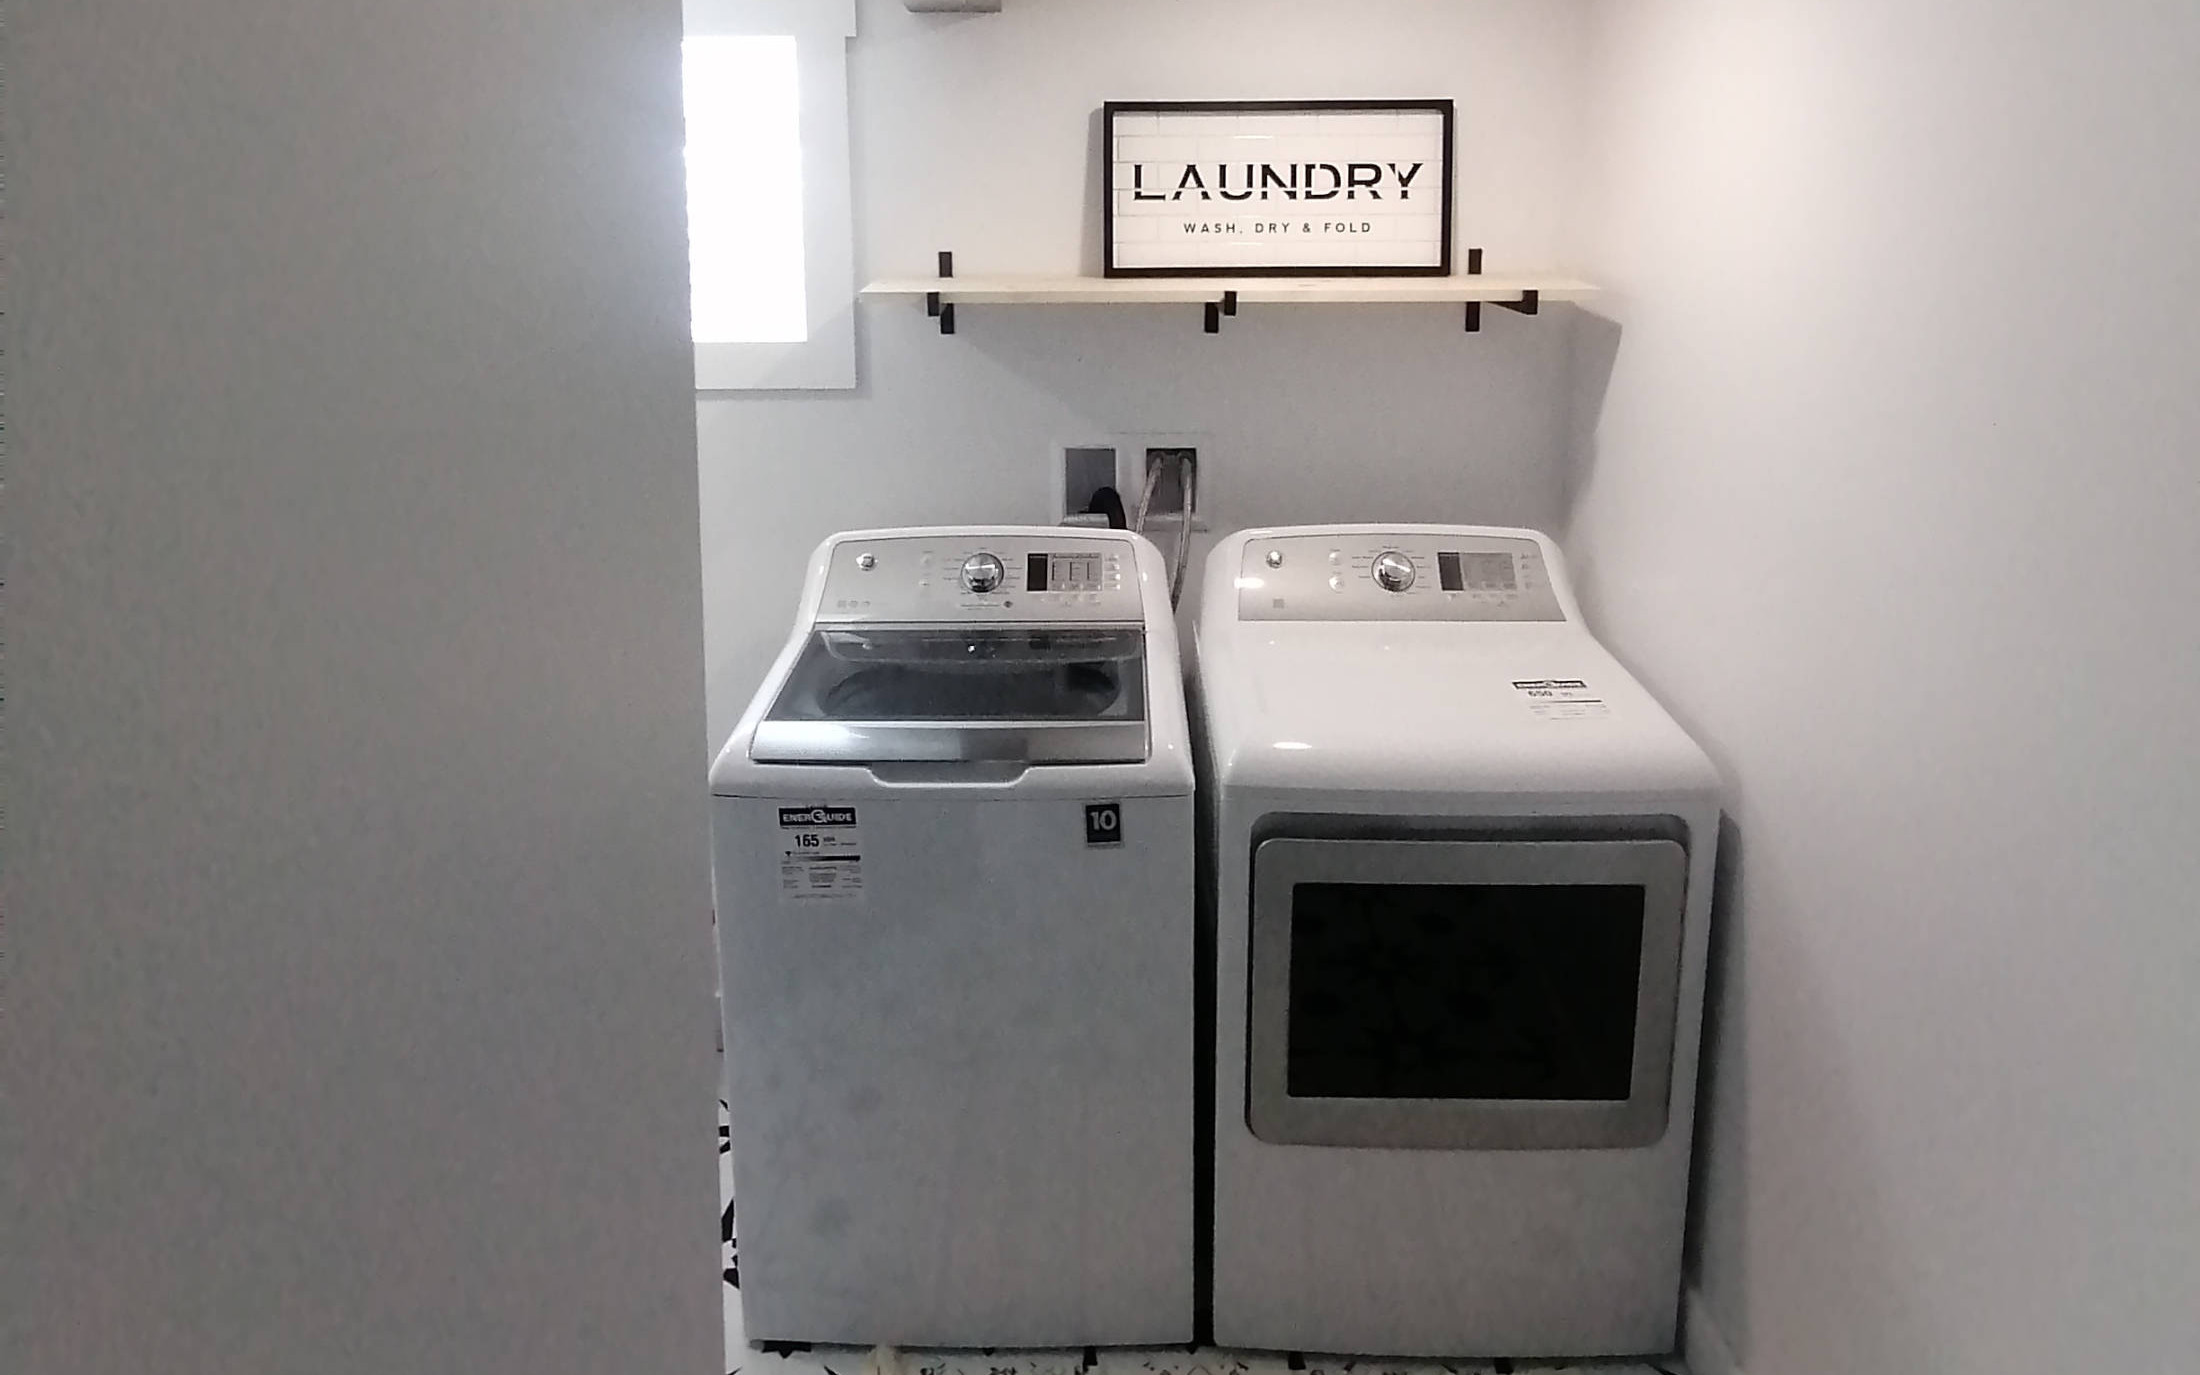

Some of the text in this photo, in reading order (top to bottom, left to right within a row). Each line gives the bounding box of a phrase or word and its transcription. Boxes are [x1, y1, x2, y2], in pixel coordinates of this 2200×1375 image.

[1133, 163, 1424, 200] LAUNDRY
[1255, 222, 1290, 233] DRY
[1302, 222, 1311, 233] &
[1324, 222, 1371, 233] FOLD
[1090, 810, 1117, 830] 10
[795, 834, 820, 847] 165
